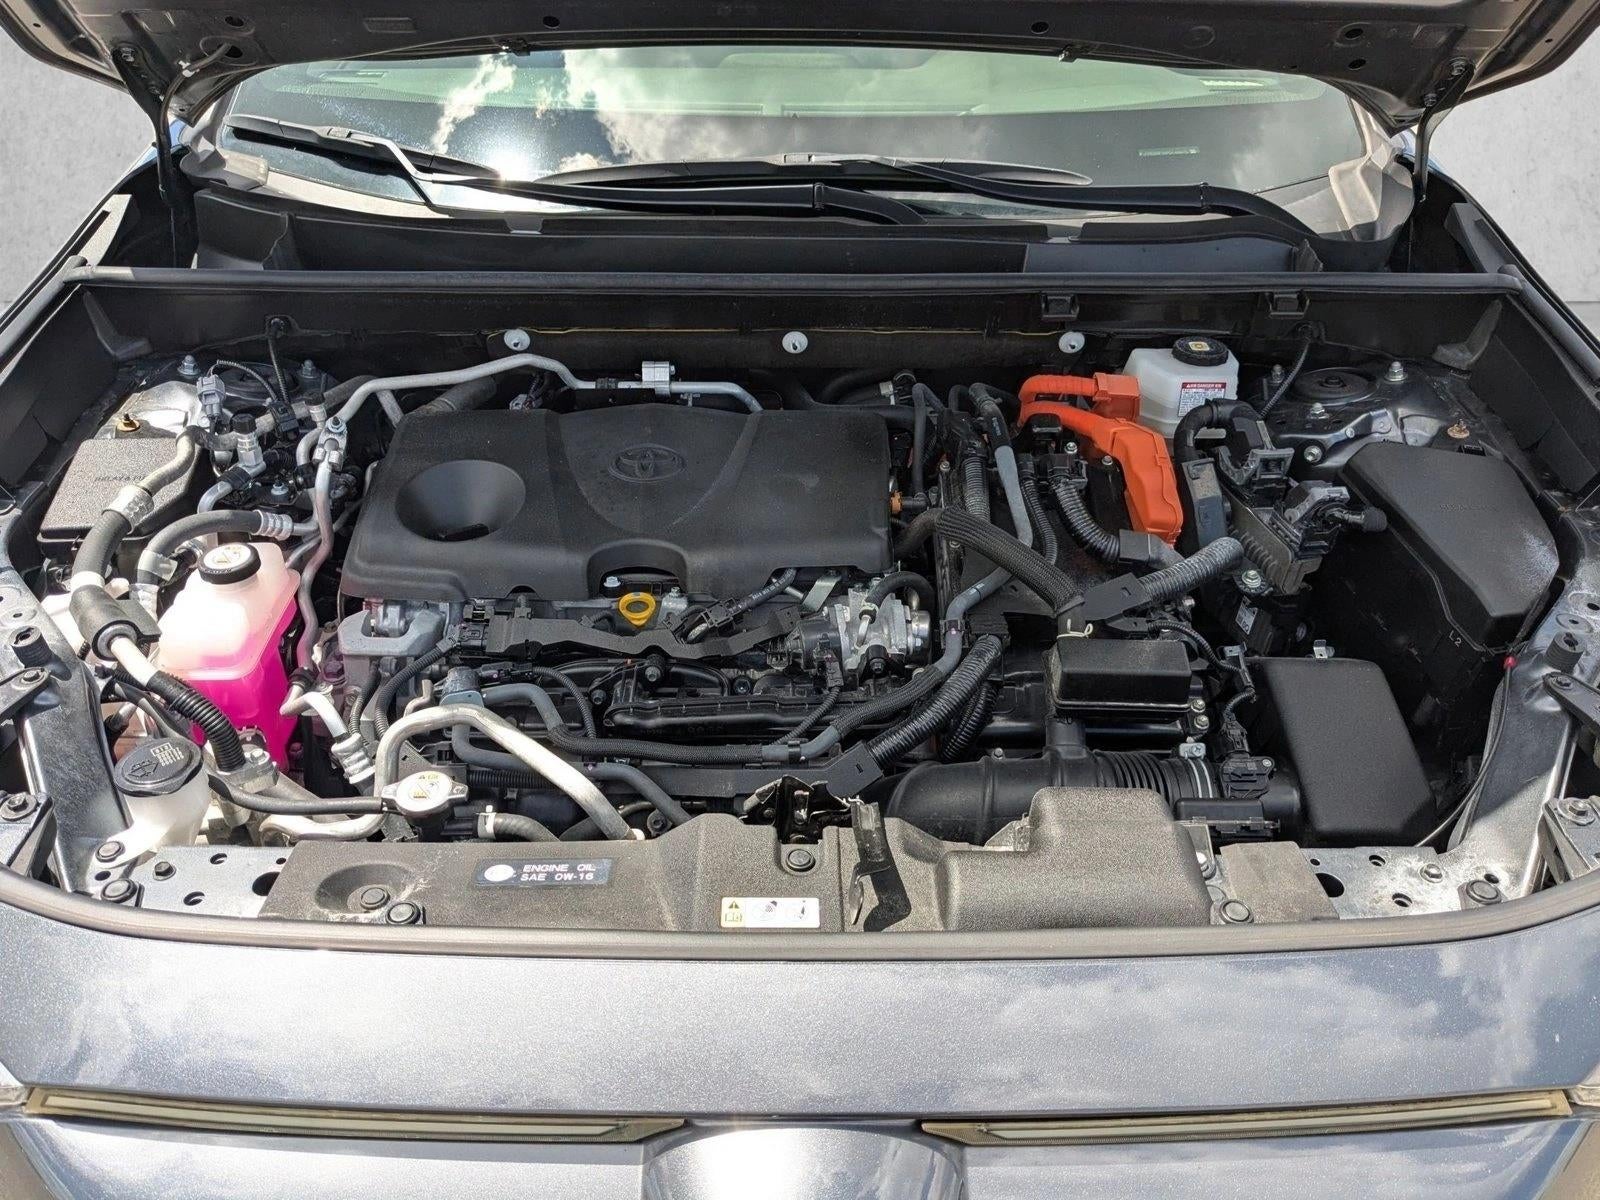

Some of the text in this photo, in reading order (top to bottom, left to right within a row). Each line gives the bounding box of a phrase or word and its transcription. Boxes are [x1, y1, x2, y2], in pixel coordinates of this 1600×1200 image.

[522, 863, 596, 872] ENGINE OIL
[520, 872, 594, 881] SAE 0W-16
